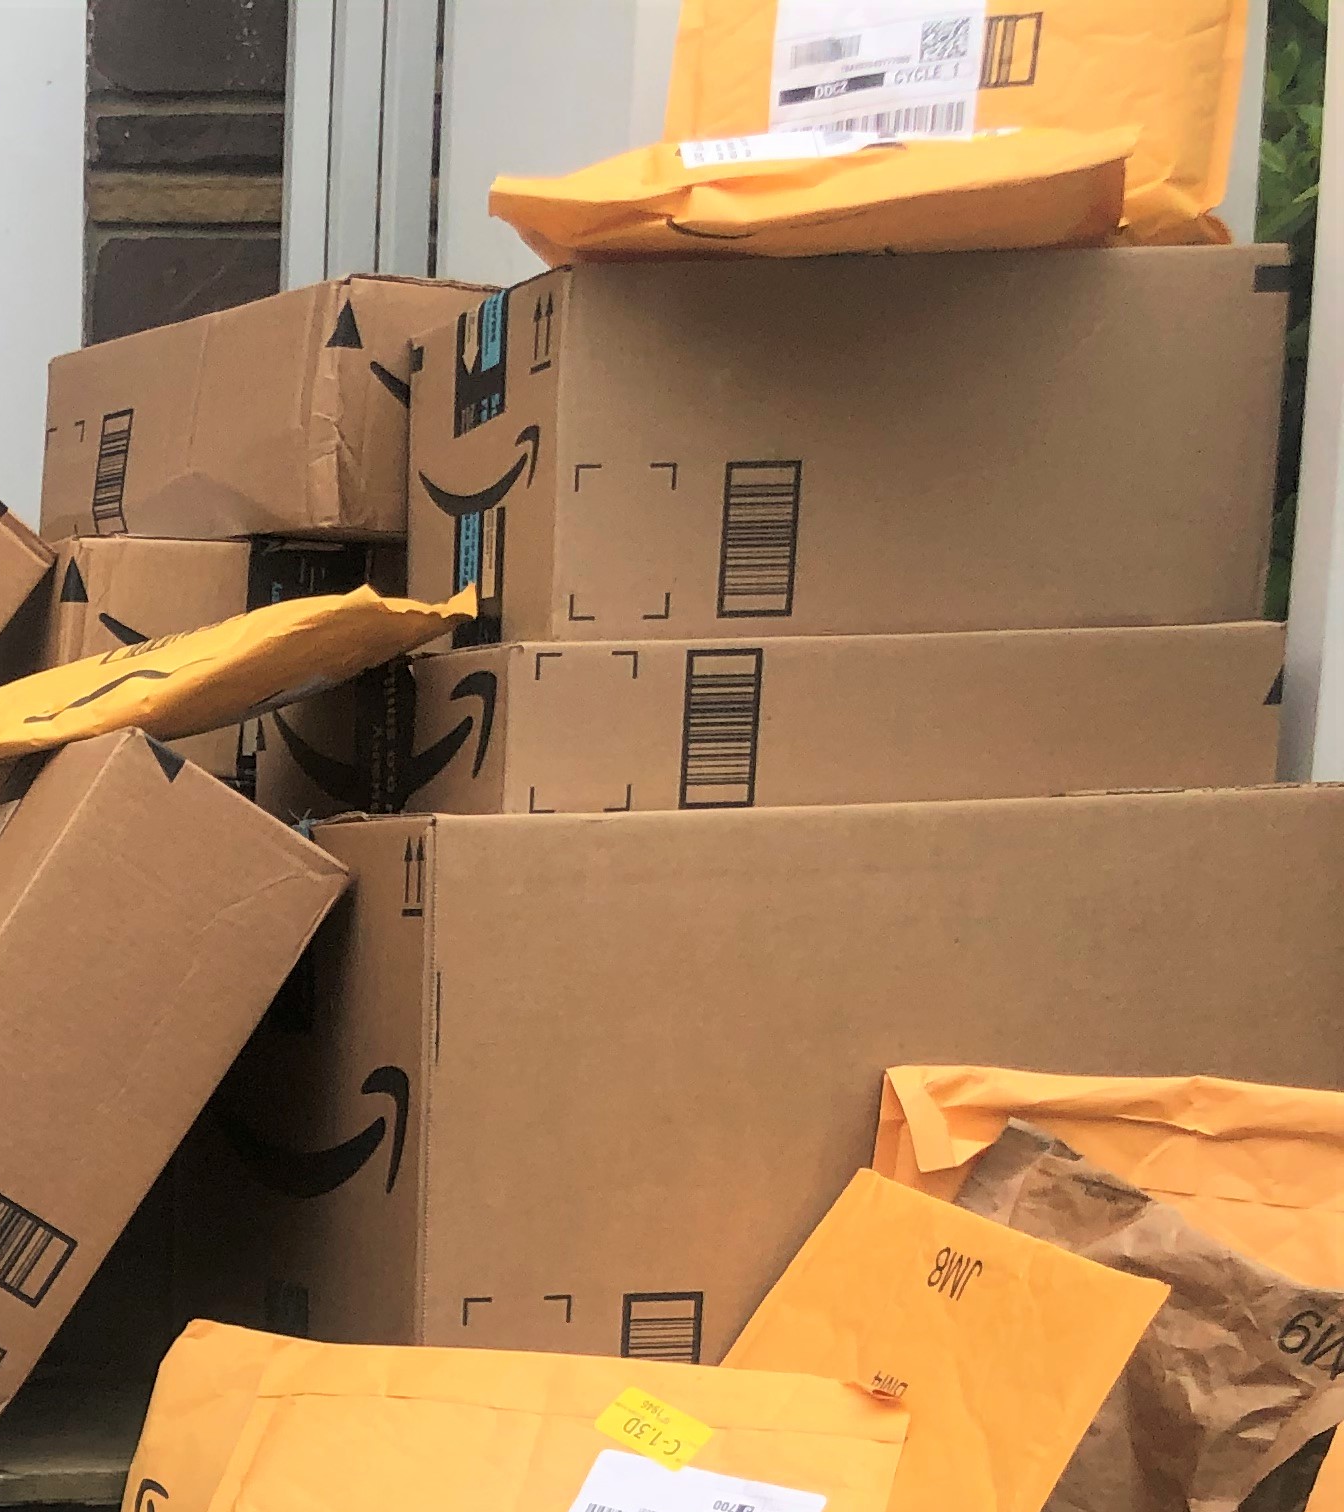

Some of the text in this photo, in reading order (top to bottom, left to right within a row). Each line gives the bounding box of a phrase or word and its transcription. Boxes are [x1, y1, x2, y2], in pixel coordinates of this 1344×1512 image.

[894, 65, 941, 85] CYCLE
[927, 1247, 983, 1301] JM8
[623, 1415, 685, 1458] C-1.3D
